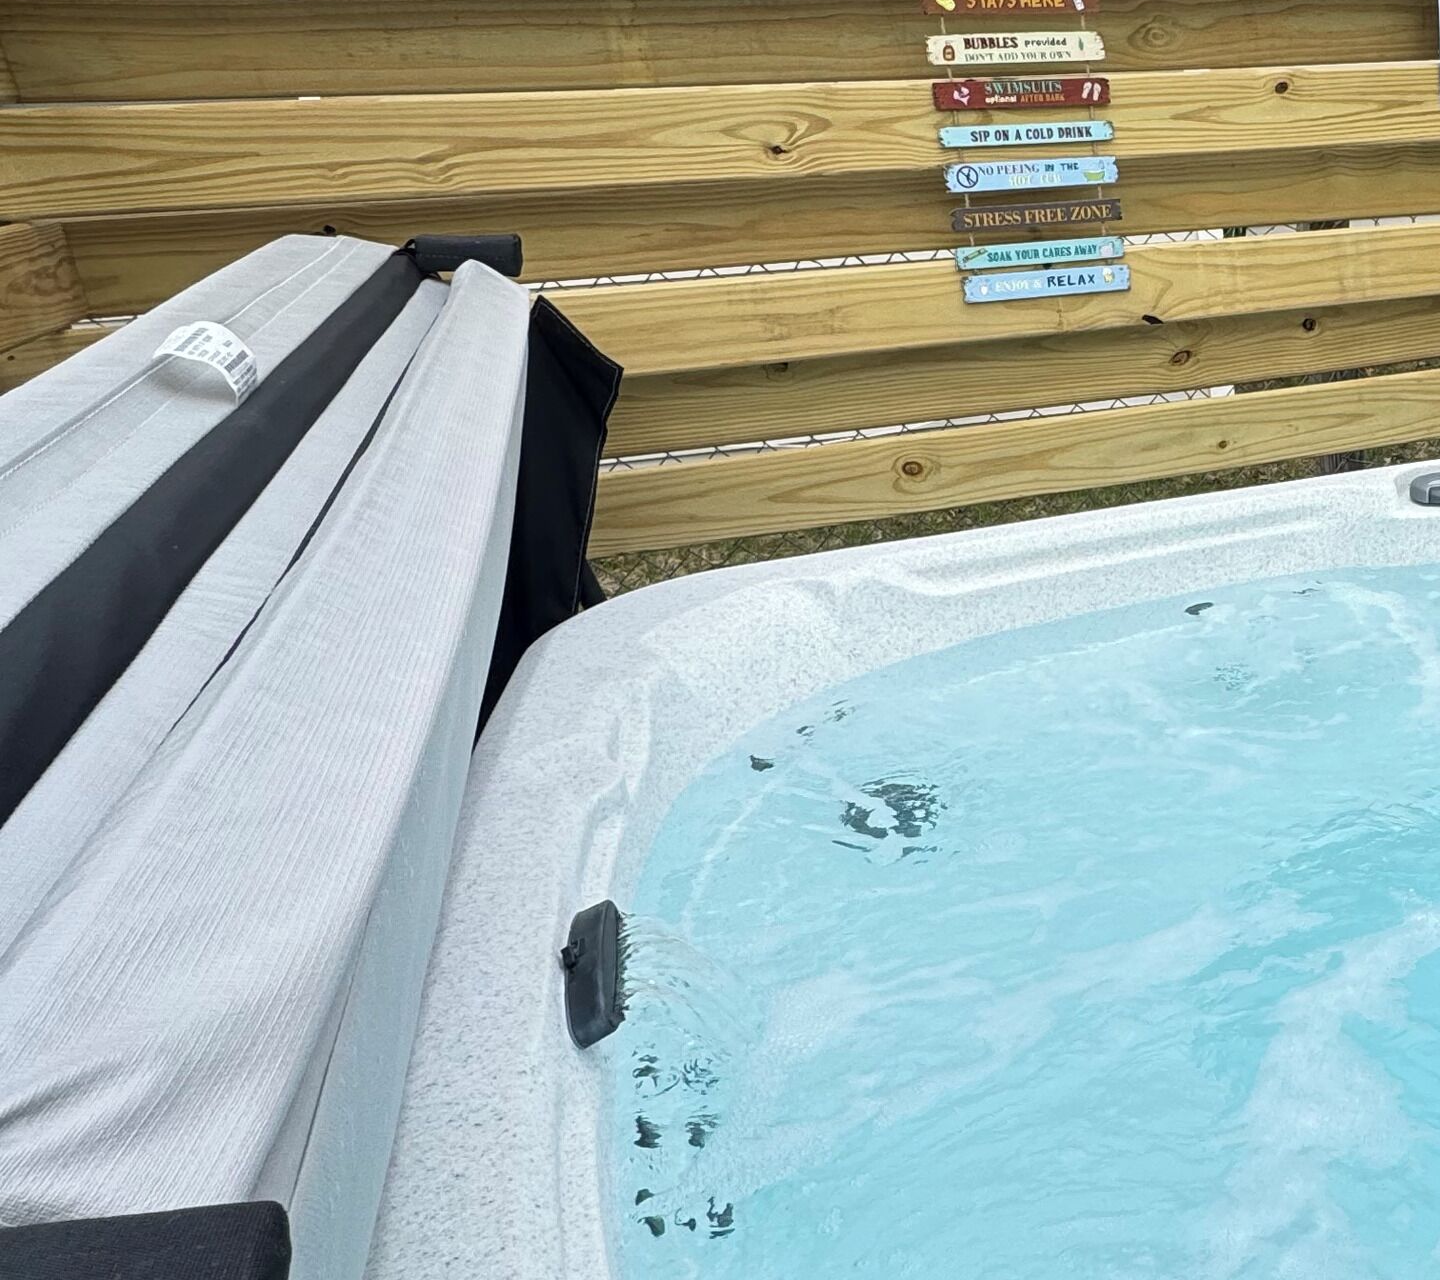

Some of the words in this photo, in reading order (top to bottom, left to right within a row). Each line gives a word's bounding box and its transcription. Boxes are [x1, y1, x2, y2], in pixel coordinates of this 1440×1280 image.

[963, 37, 1019, 50] BUBBLES
[1024, 37, 1067, 49] provided
[964, 52, 994, 63] DON'T
[998, 52, 1019, 62] ADD
[1021, 51, 1047, 62] YOUR
[1050, 50, 1072, 61] OWN
[984, 80, 1062, 95] SWIMSUITS
[985, 95, 1017, 104] optional
[970, 130, 991, 143] SIP
[994, 129, 1010, 142] ON
[1014, 128, 1023, 141] A
[1026, 127, 1054, 140] COLD
[1057, 126, 1093, 139] DRINK
[978, 165, 994, 177] NO
[997, 163, 1040, 176] PEEING
[1044, 163, 1055, 173] IN
[1061, 162, 1080, 172] THE
[963, 210, 1022, 229] STRESS
[1025, 208, 1067, 225] FREE
[1070, 204, 1113, 221] ZONE
[986, 251, 1013, 264] SOAK
[1015, 249, 1040, 261] YOUR
[1042, 246, 1072, 259] CARES
[1074, 244, 1098, 257] AWAY
[994, 280, 1030, 294] ENJOY
[1033, 278, 1042, 290] &
[1046, 273, 1096, 289] RELAX
